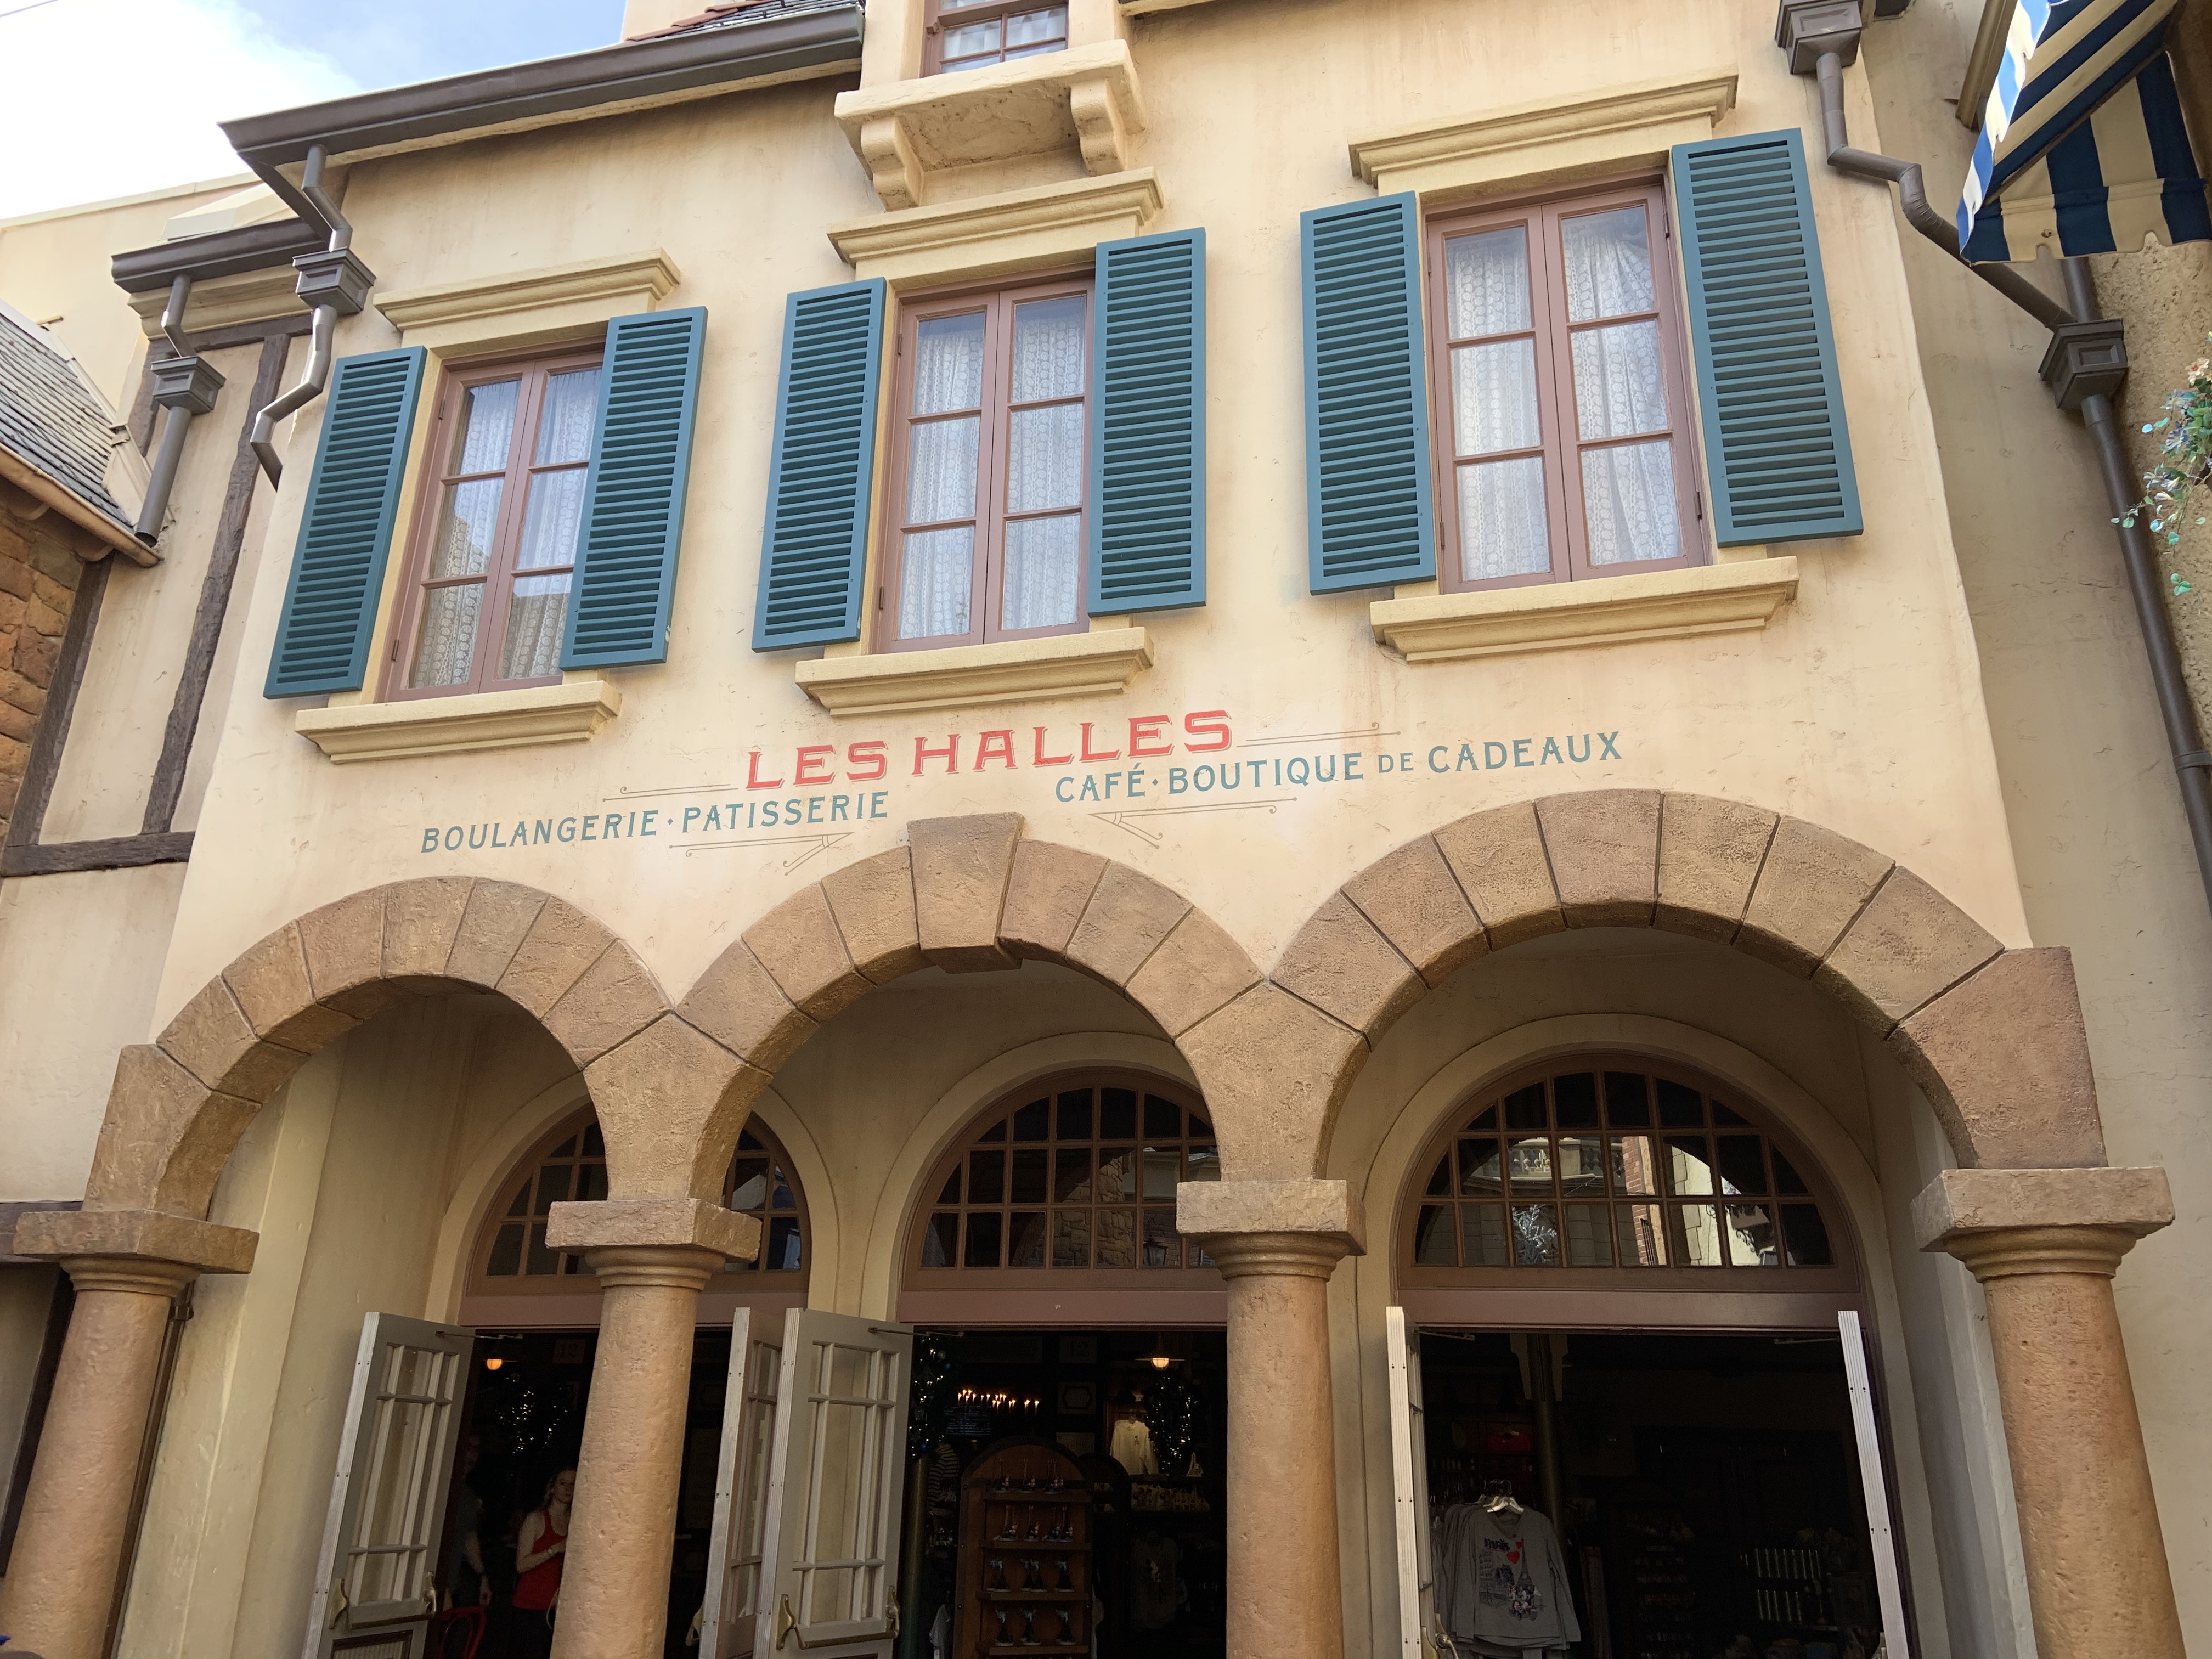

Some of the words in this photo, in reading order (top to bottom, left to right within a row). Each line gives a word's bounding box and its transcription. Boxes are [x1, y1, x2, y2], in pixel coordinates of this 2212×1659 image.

[746, 741, 888, 791] LES
[912, 710, 1232, 776] HALLES
[1056, 763, 1145, 802] CAFÉ
[1168, 752, 1363, 794] BOUTIQUE
[1378, 752, 1414, 773] DE
[1429, 731, 1622, 773] CADEAUX
[421, 810, 658, 853] BOULANGERIE
[682, 791, 888, 833] PATISSERIE
[1069, 1341, 1090, 1357] 12
